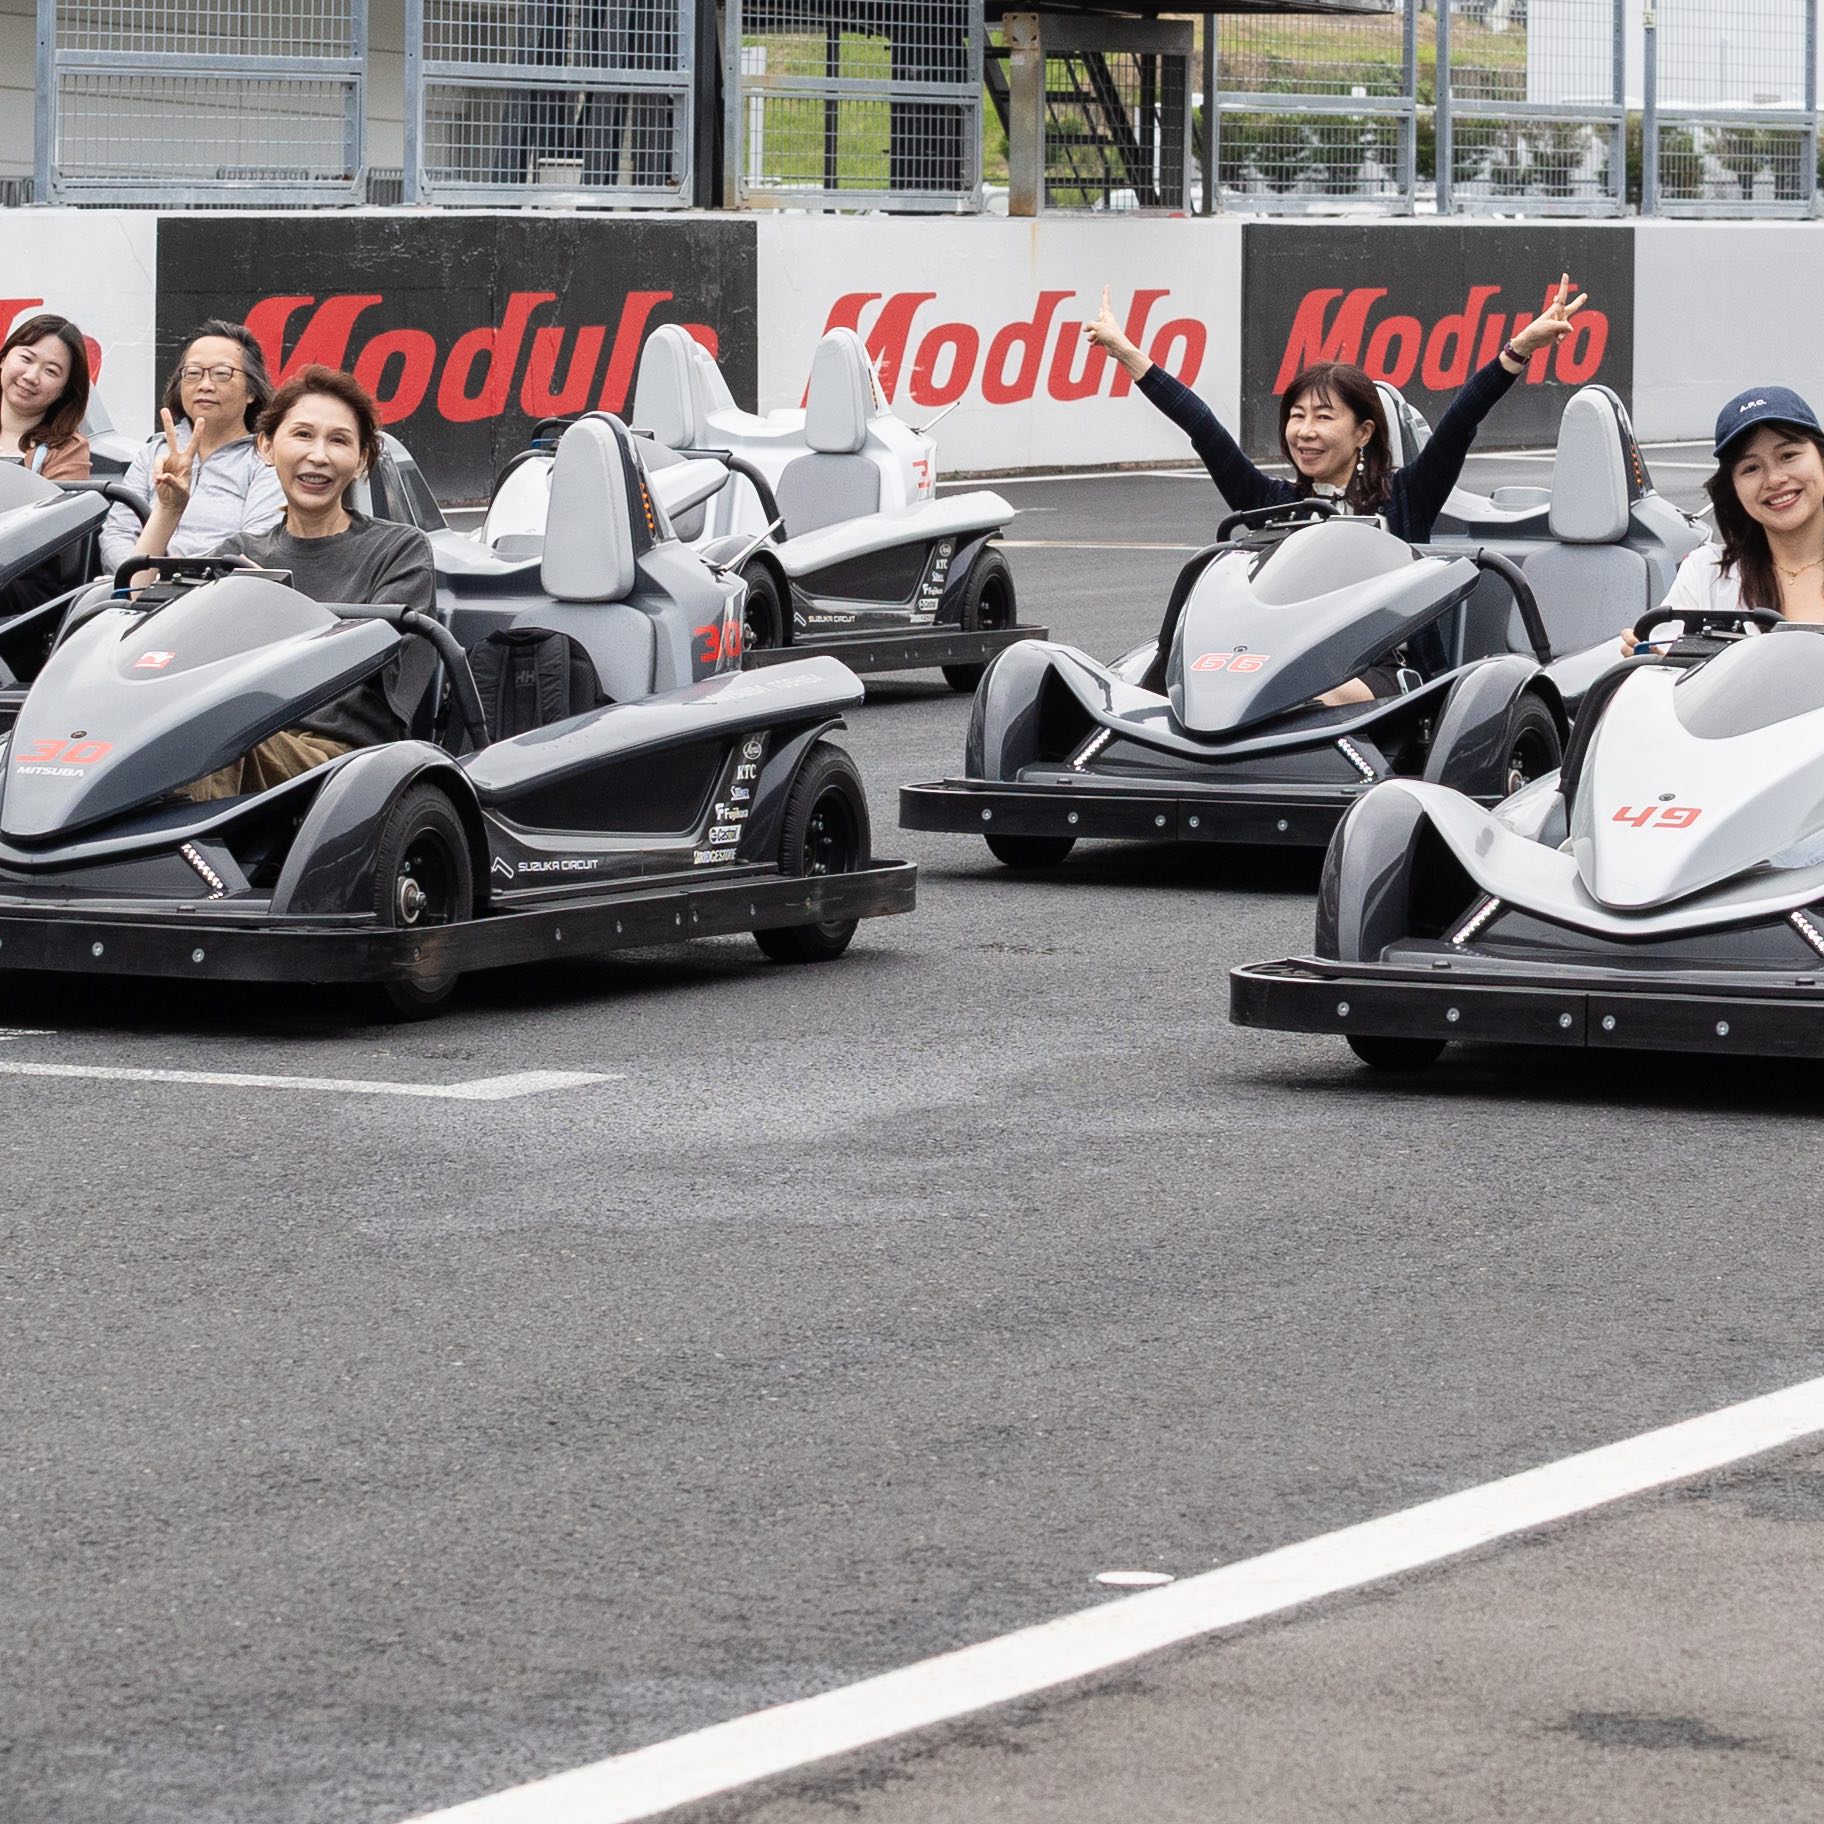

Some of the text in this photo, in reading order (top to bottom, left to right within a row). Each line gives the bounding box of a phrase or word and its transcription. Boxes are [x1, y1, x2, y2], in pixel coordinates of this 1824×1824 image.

[240, 291, 719, 426] Modul
[693, 620, 742, 663] 30
[1189, 652, 1271, 673] 66
[15, 739, 116, 764] 30
[17, 766, 85, 778] MITSUBA
[736, 764, 757, 780] KTC
[1611, 806, 1703, 829] 49
[518, 859, 599, 873] SUZUKA CIRCUIT
